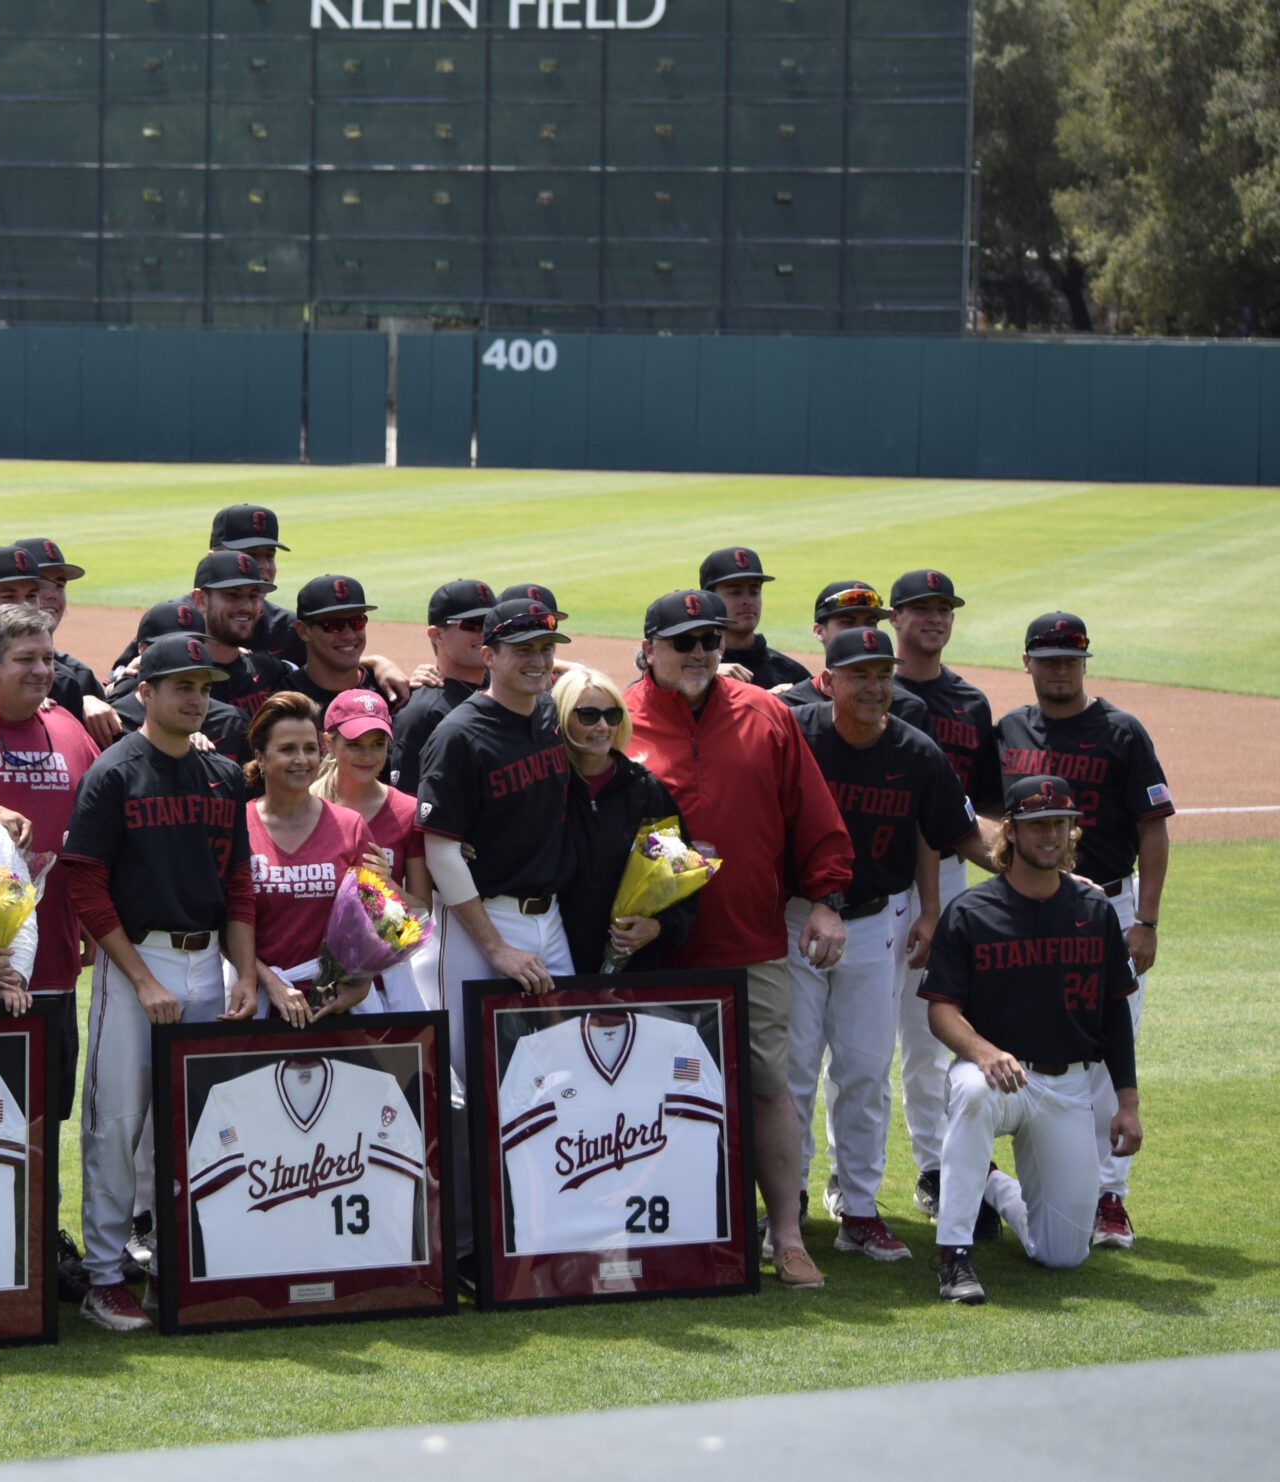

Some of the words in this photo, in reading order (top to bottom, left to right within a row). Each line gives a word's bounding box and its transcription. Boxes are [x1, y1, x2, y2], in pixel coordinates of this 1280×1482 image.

[310, 0, 478, 29] KLEIN
[481, 338, 557, 371] 400
[250, 854, 336, 883] SENIOR
[253, 880, 336, 894] STRONG
[975, 937, 1104, 971] STANFORD
[1064, 971, 1100, 1010] 24
[554, 1101, 668, 1193] Stanford
[247, 1131, 365, 1212] Stanford
[331, 1194, 370, 1236] 13
[625, 1195, 670, 1234] 28
